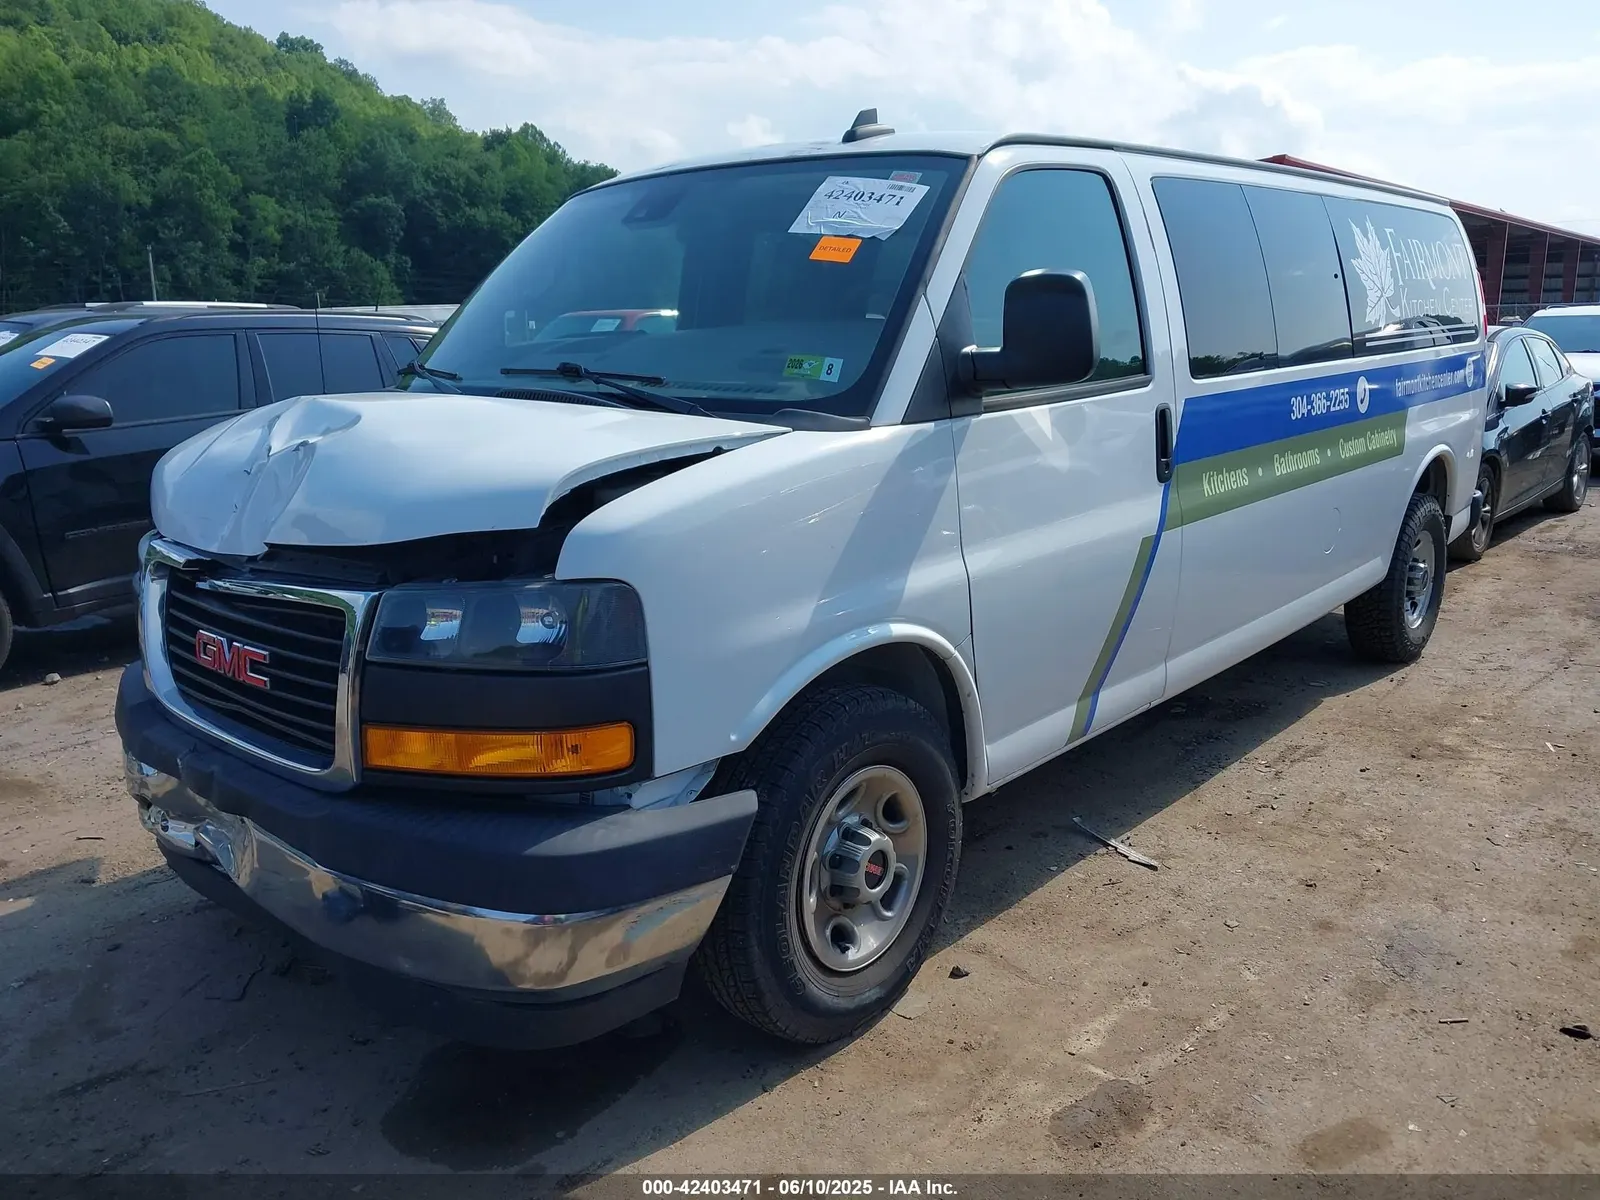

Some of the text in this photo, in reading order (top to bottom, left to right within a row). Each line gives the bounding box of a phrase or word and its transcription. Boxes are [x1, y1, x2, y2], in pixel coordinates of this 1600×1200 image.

[824, 189, 905, 206] 42403471
[818, 244, 852, 254] DETAILED
[1384, 228, 1468, 290] FAIRMONT
[1399, 286, 1474, 319] KITCHEN CENTER
[826, 363, 834, 375] 8
[1290, 388, 1350, 420] 304-366-2255
[1202, 426, 1398, 498] Kitchens Bathrooms Custom Cabinetry
[195, 628, 271, 690] GMC
